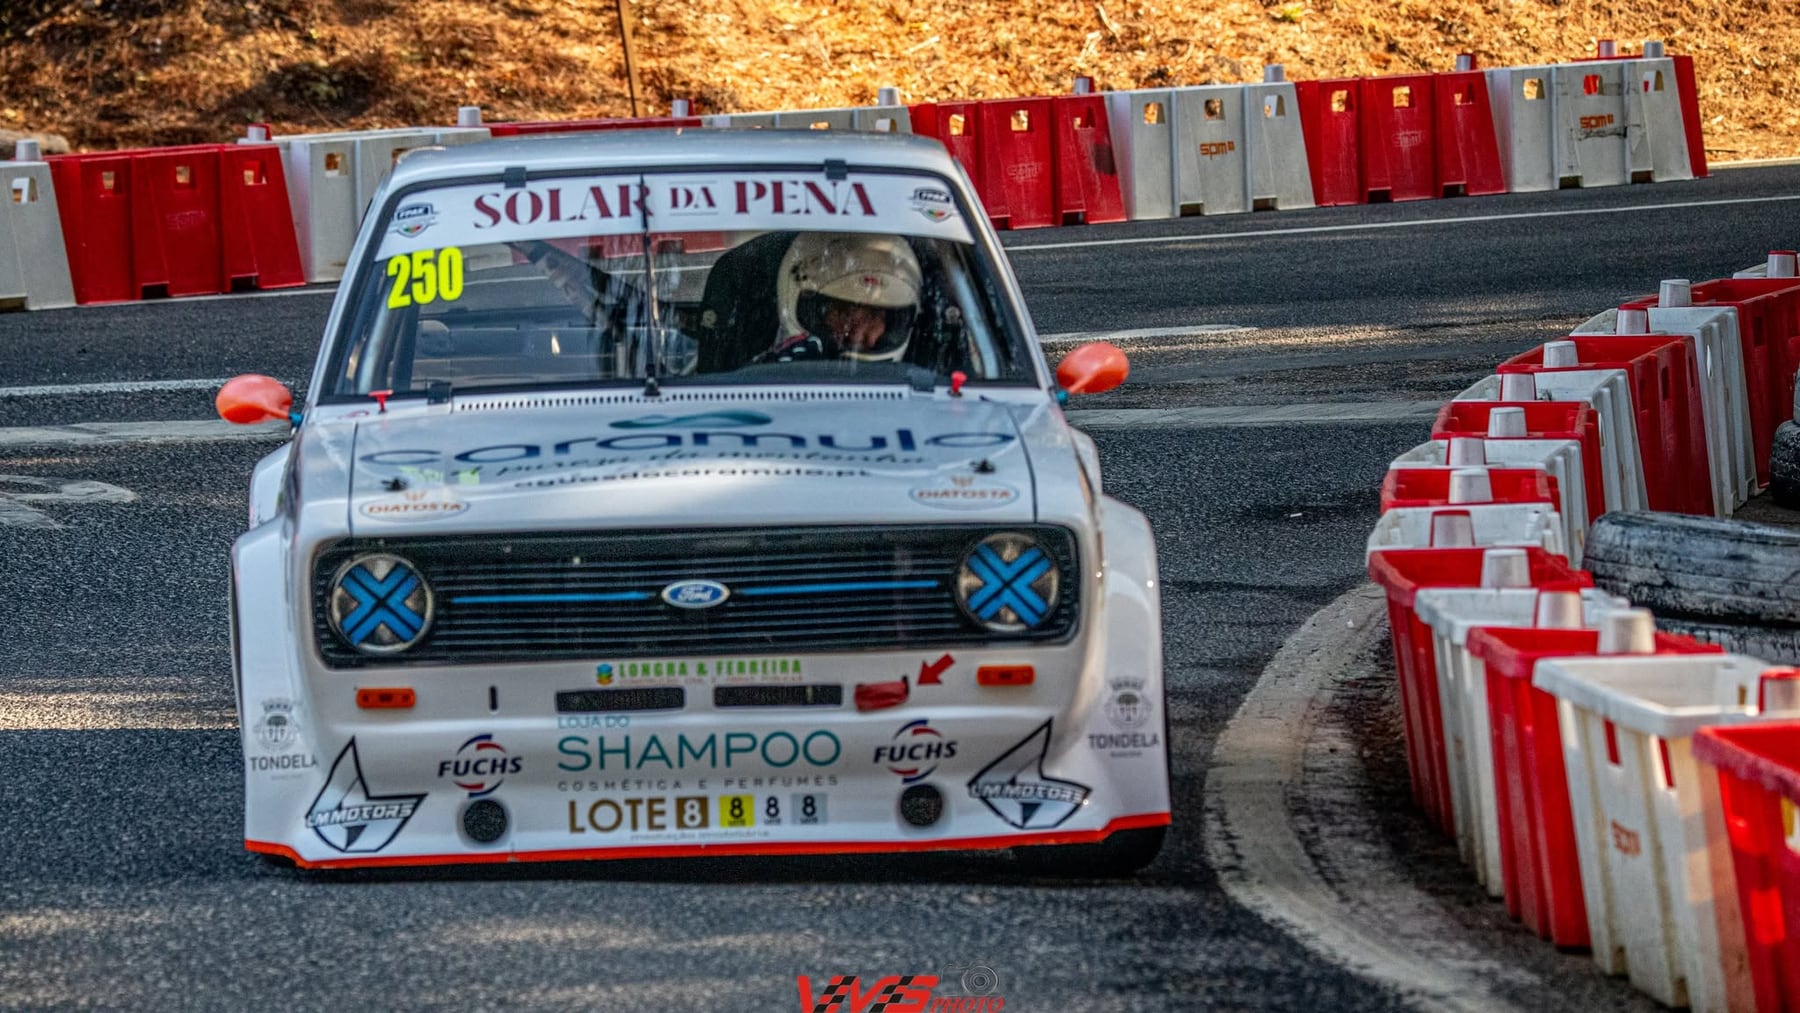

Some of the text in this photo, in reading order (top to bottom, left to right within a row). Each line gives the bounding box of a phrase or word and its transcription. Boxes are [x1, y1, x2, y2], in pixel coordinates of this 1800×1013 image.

[474, 181, 877, 229] SOLAR DA PENA
[388, 246, 464, 309] 250
[359, 428, 1016, 465] caramulo
[716, 659, 801, 676] FERREIRA
[558, 715, 630, 729] LOJA DO
[558, 730, 842, 772] SHAMPOO
[873, 741, 957, 763] FUCHS
[1088, 733, 1160, 751] TONDELA
[250, 753, 320, 772] TONDELA
[438, 756, 523, 778] FUCHS
[698, 778, 707, 790] E
[724, 775, 839, 788] PERFUMES
[568, 798, 702, 834] LOTE 8
[730, 796, 744, 819] 8
[766, 796, 780, 818] 8
[802, 795, 816, 817] 8
